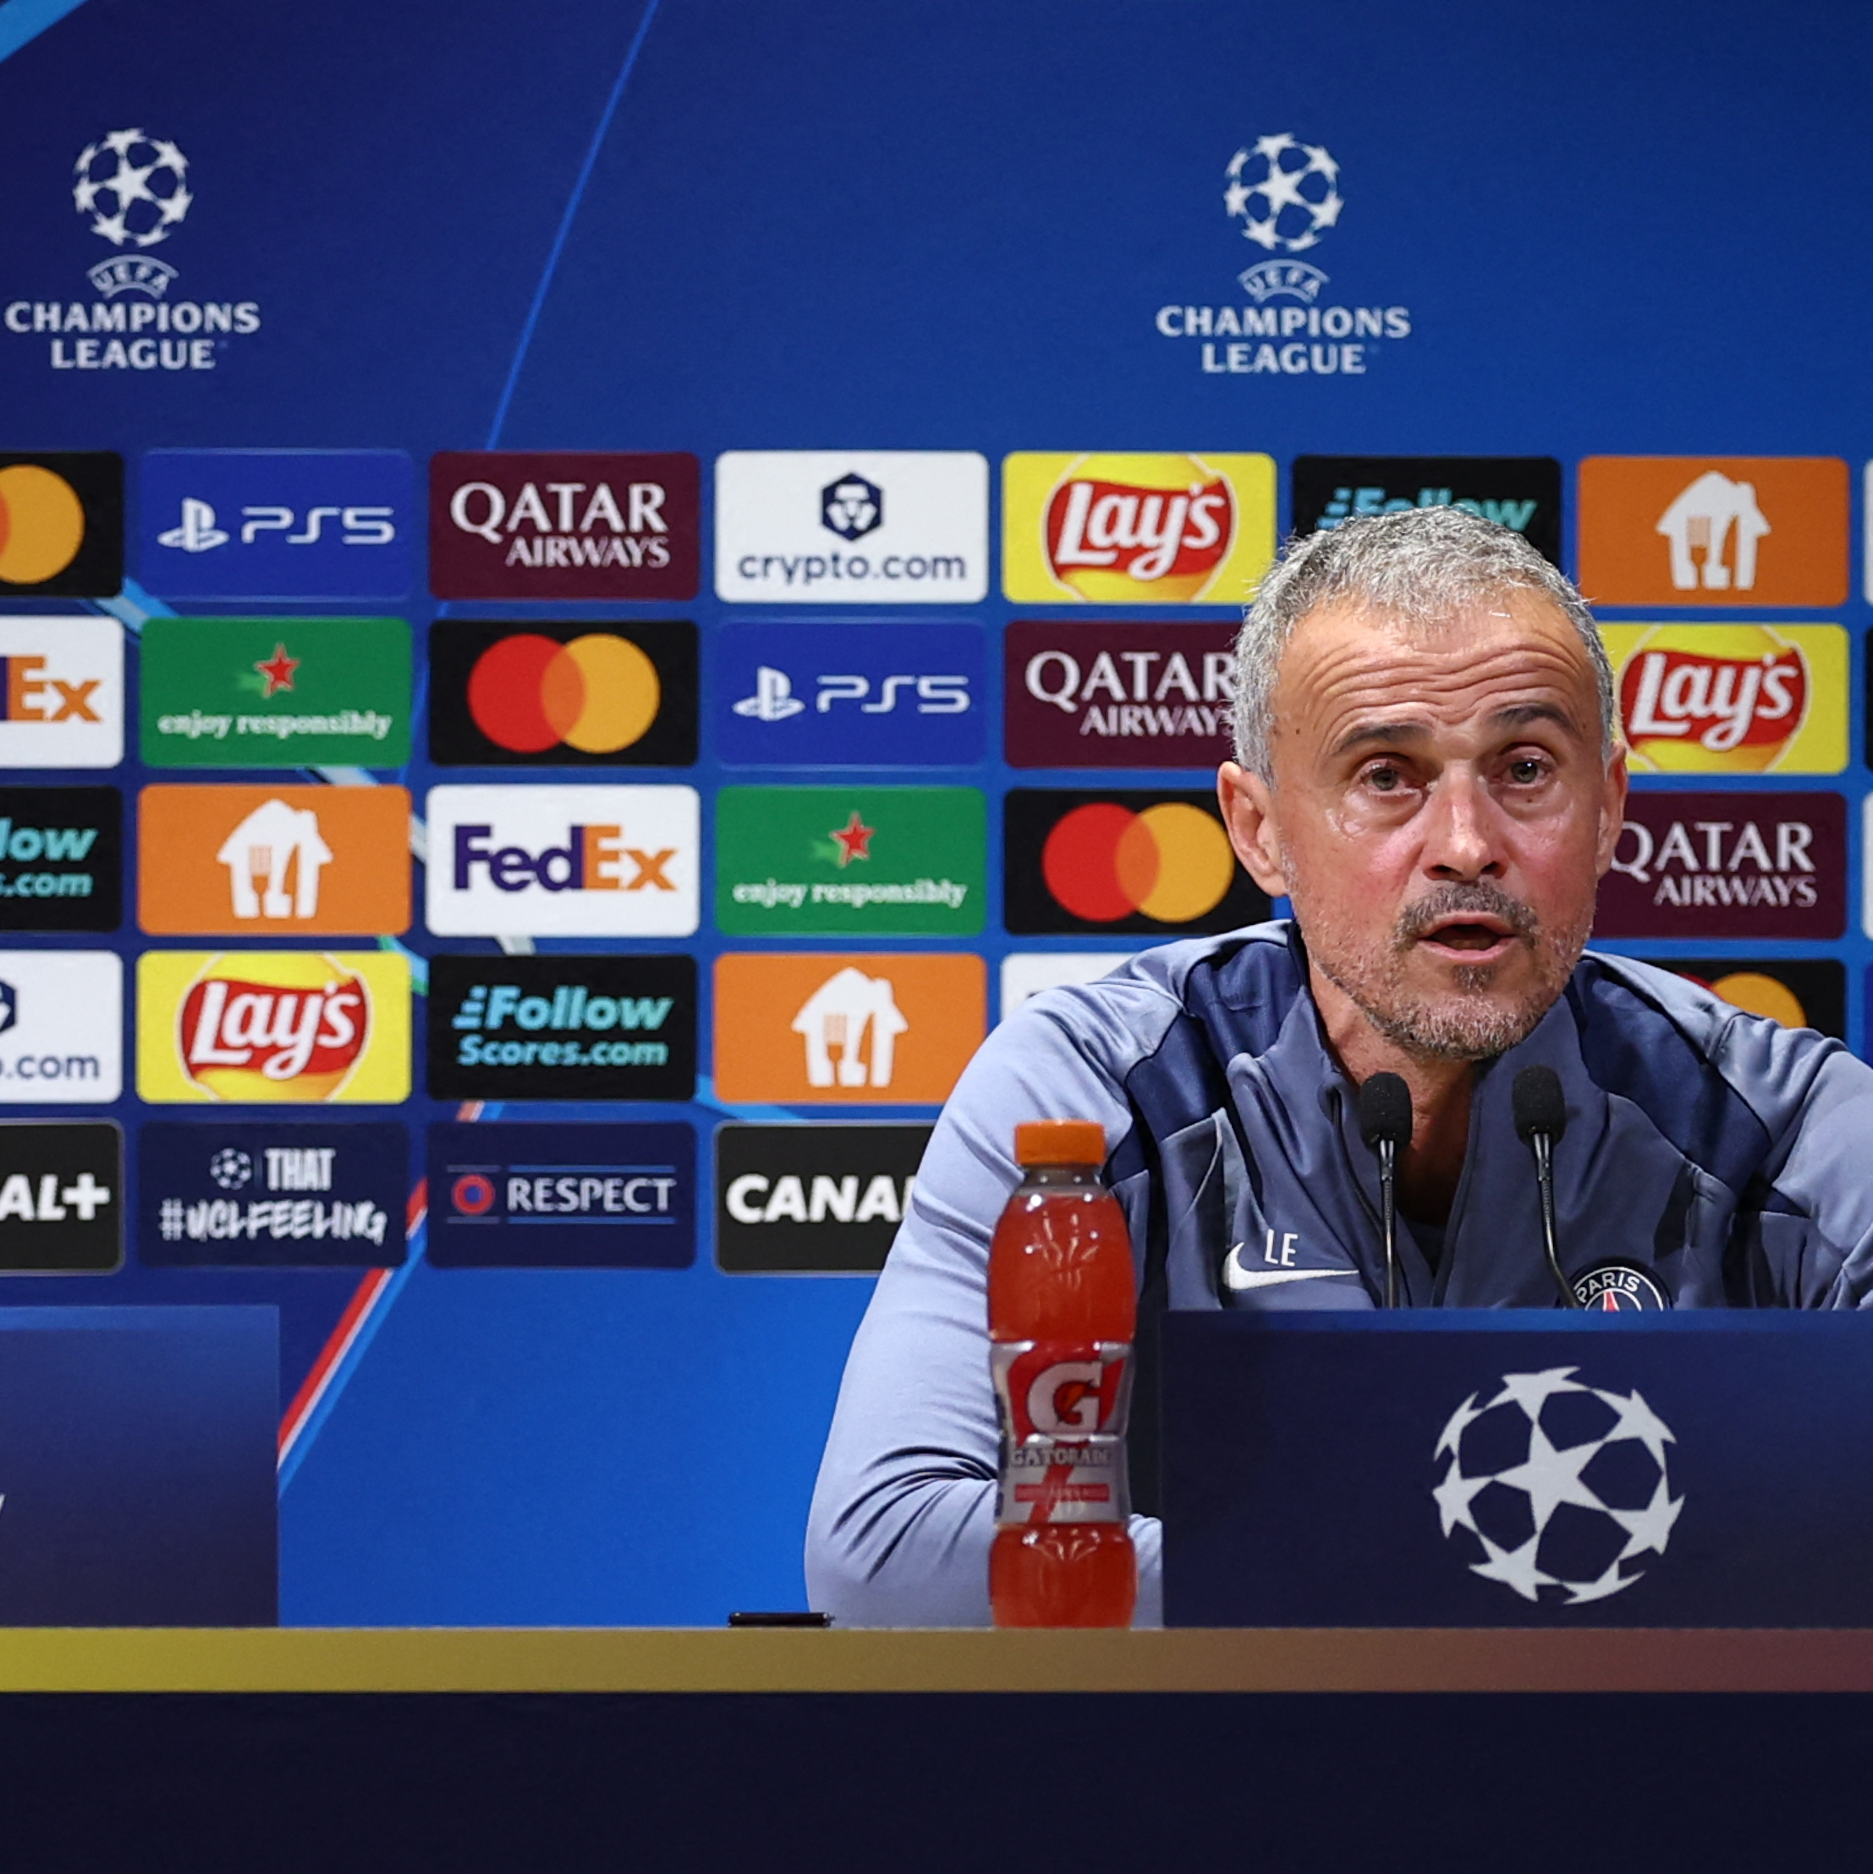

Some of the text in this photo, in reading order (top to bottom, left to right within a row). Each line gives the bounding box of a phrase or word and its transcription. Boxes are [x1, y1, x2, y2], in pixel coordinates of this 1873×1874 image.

[92, 262, 170, 292] UEFA
[1243, 266, 1321, 297] UEFA
[5, 301, 260, 333] CHAMPIONS
[1156, 306, 1411, 338] CHAMPIONS
[50, 339, 216, 370] LEAGUE
[1202, 343, 1366, 374] LEAGUE
[241, 507, 395, 544] PS5
[452, 484, 666, 553] QATAR
[1056, 487, 1225, 583] Lay's
[508, 538, 670, 569] AIRWAYS
[738, 551, 966, 590] crypto.com
[816, 675, 970, 713] PS5
[1025, 650, 1236, 713] QATAR
[157, 710, 392, 740] enjoy responsibly
[1632, 658, 1801, 754] Lay's
[453, 823, 676, 894] FedEx
[1611, 822, 1816, 883] QATAR
[732, 879, 967, 908] enjoy responsibly
[1653, 875, 1817, 907] AIRWAYS
[485, 986, 672, 1030] Follow
[194, 985, 363, 1081] Lay's
[458, 1034, 668, 1066] Scores.com
[265, 1148, 335, 1190] THAT
[507, 1177, 675, 1212] RESPECT
[726, 1173, 916, 1224] CANA
[161, 1199, 387, 1244] #UCLFEELING
[1263, 1229, 1300, 1267] LE
[1576, 1272, 1640, 1303] PARIS
[1028, 1361, 1102, 1442] G
